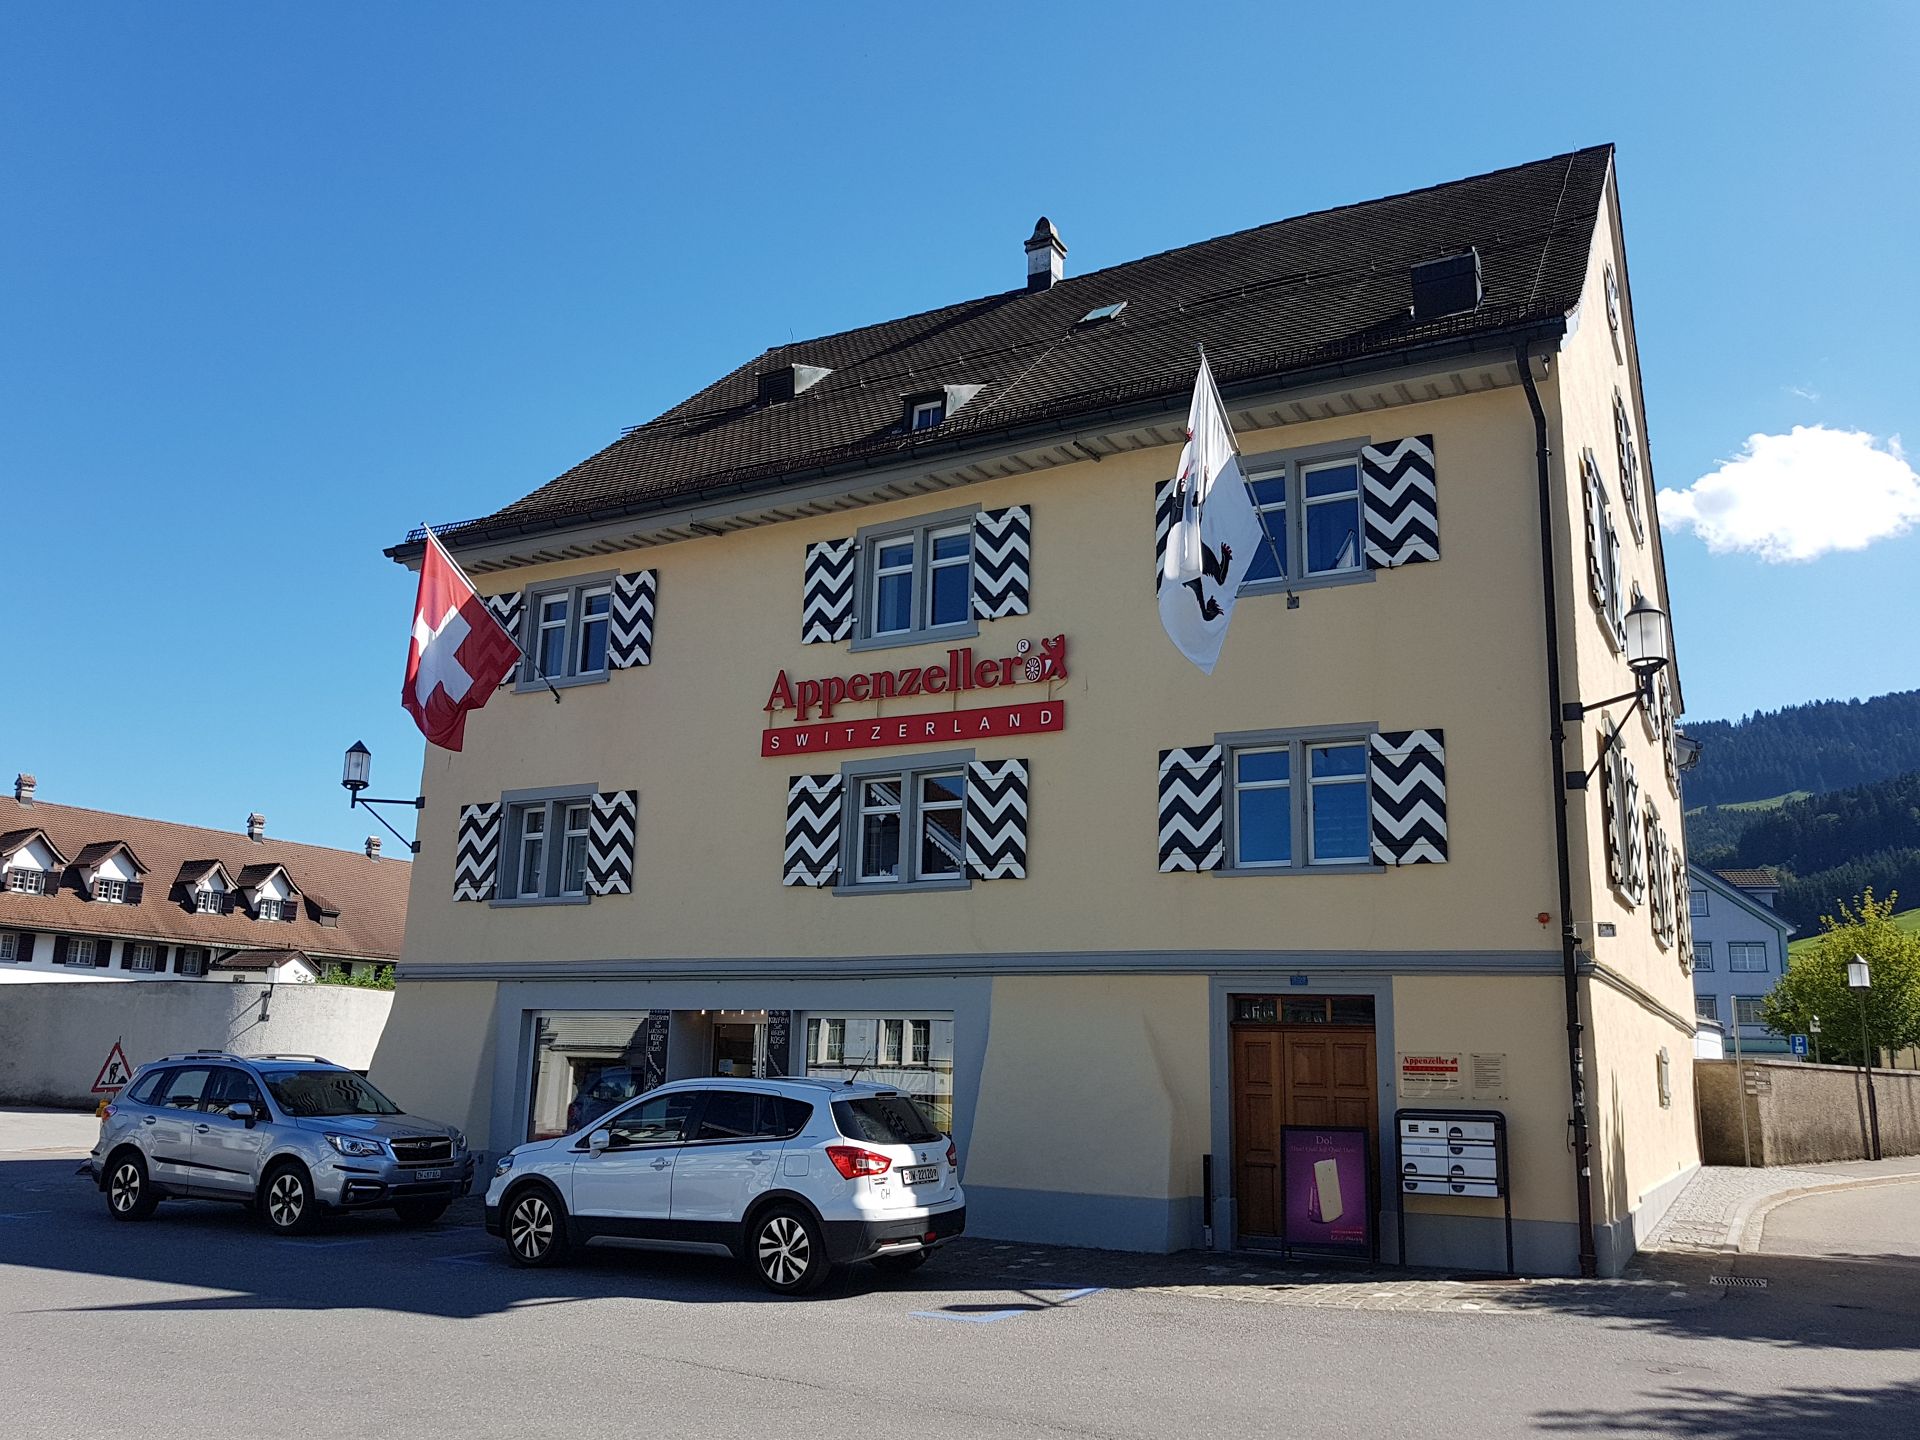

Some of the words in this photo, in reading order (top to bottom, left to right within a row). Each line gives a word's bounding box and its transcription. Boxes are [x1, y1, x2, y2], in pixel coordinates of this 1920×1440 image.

[763, 647, 1022, 721] Appenzeller
[771, 710, 1052, 749] SWITZERLAND
[1795, 1036, 1803, 1045] P
[1402, 1056, 1449, 1065] Appenzeller
[880, 1188, 891, 1200] CH
